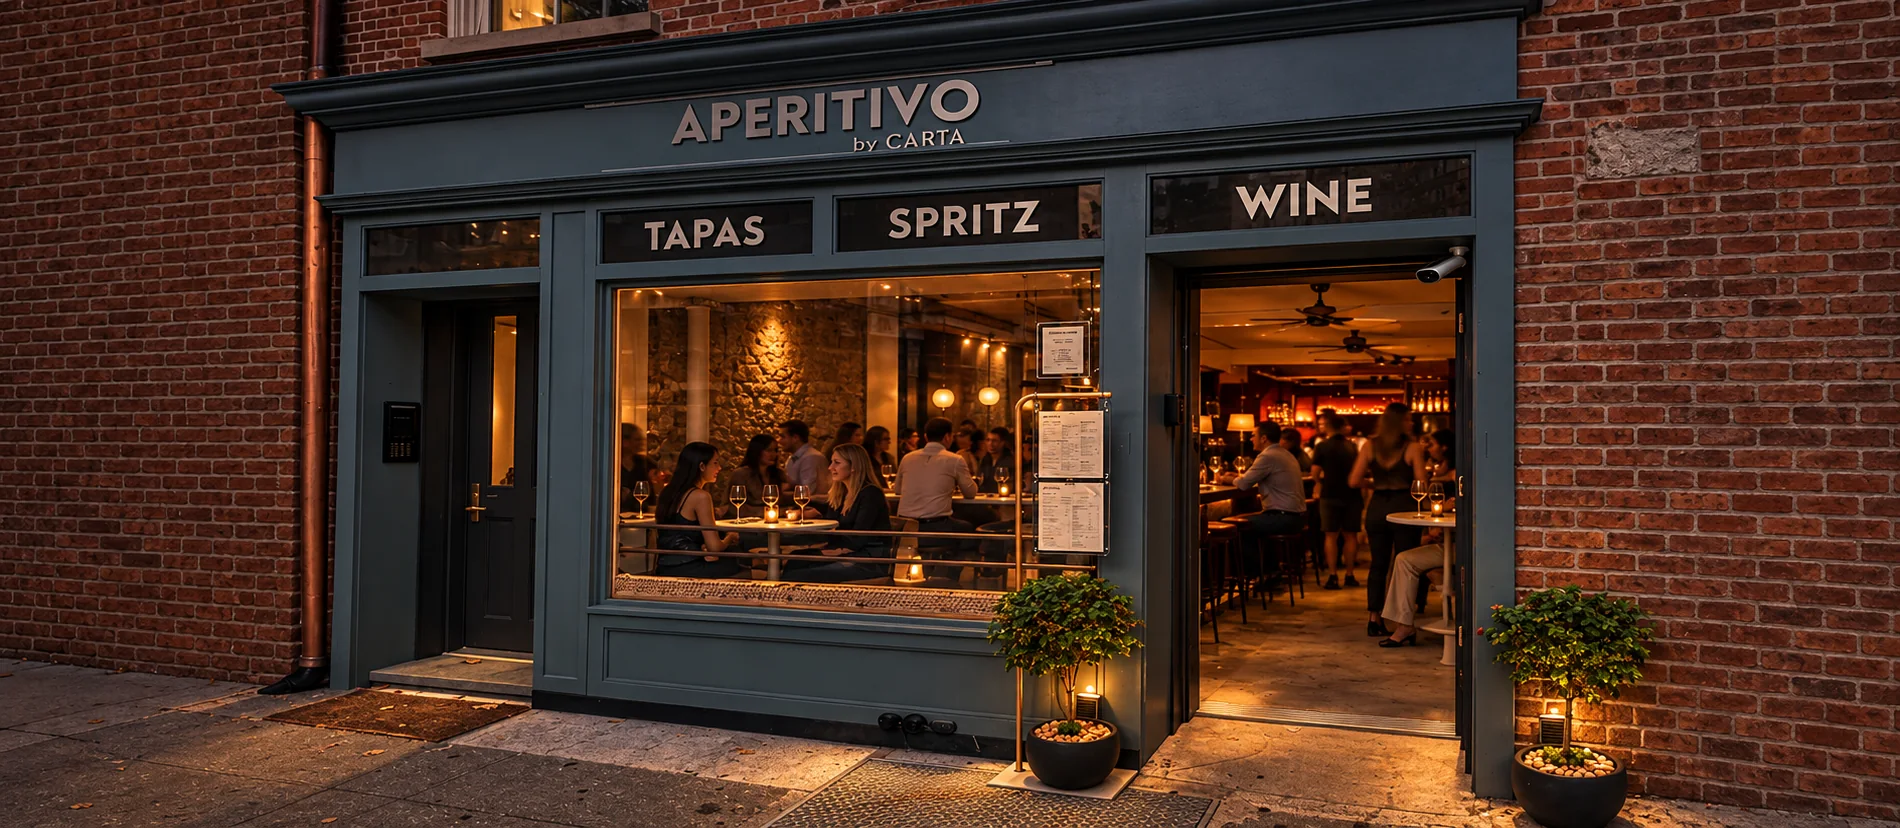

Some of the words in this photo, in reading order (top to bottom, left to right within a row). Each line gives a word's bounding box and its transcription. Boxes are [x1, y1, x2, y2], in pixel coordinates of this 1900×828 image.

[671, 79, 980, 144] APERITIVO
[853, 137, 877, 152] by
[886, 128, 965, 149] CARTA
[1235, 177, 1373, 220] WINE
[644, 215, 765, 251] TAPAS
[888, 200, 1040, 239] SPRITZ
